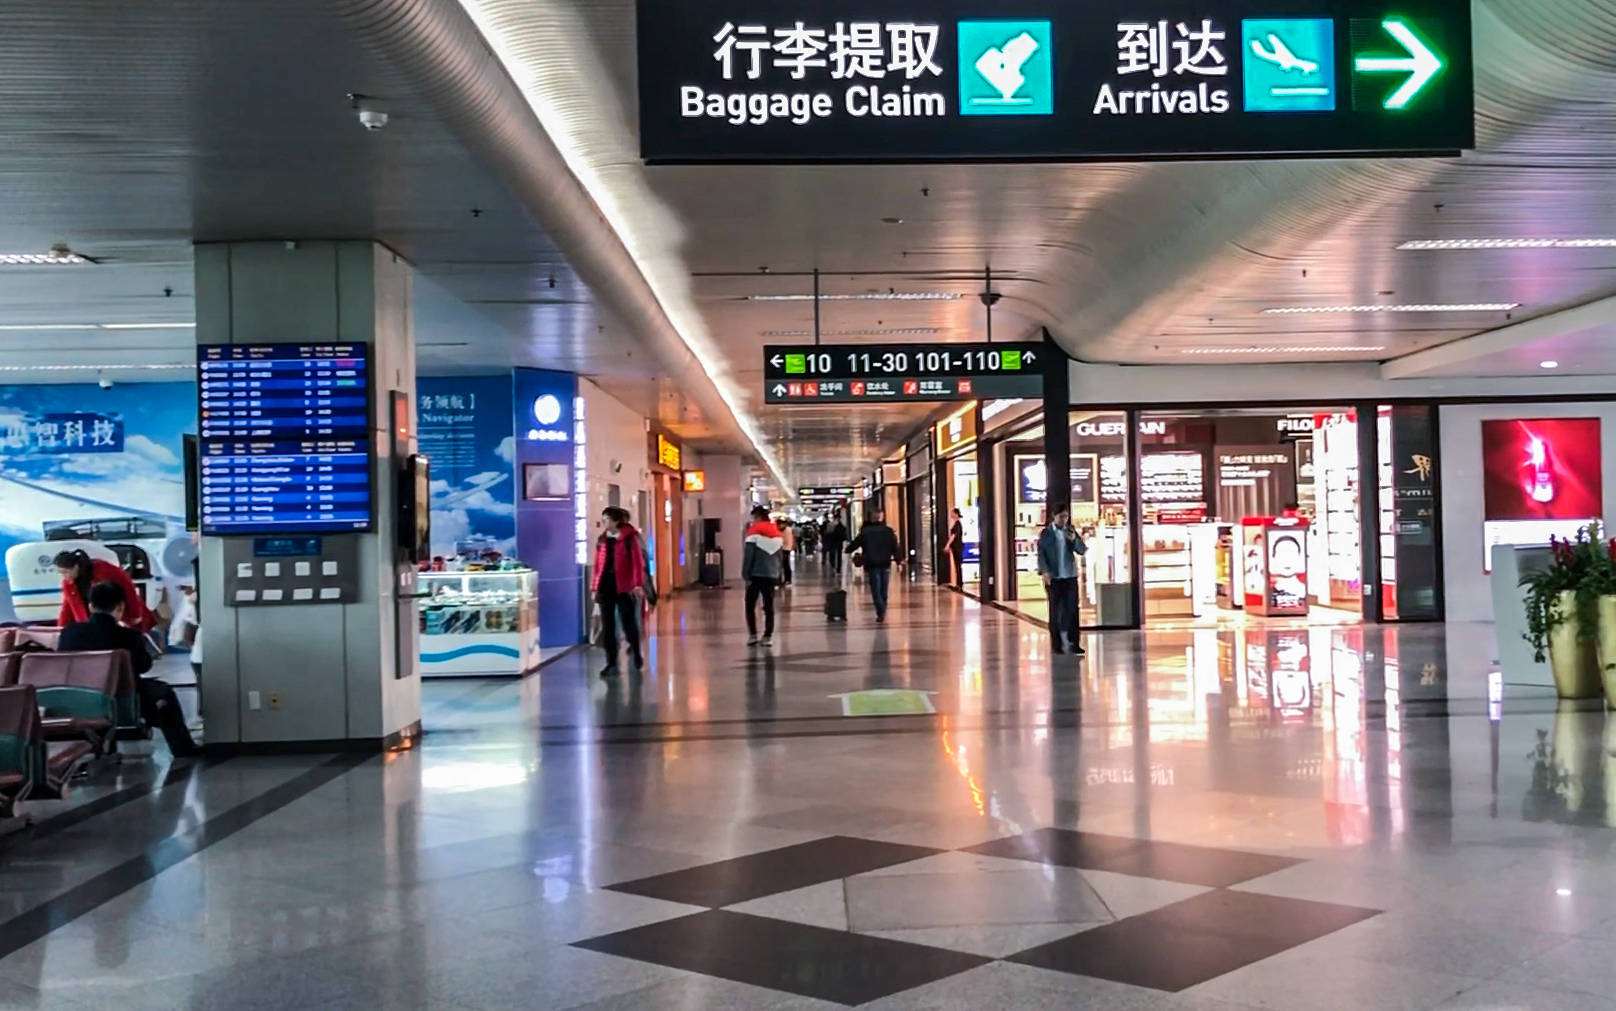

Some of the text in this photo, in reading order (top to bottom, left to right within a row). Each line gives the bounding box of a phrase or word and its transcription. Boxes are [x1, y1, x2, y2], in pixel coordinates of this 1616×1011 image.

[712, 20, 944, 80] 行李提取
[1115, 19, 1229, 78] 到达
[681, 84, 947, 126] Baggage Claim
[1092, 81, 1230, 115] Arrivals
[806, 350, 1000, 373] 10 11-30 101-110
[1076, 421, 1166, 436] GUERAIN
